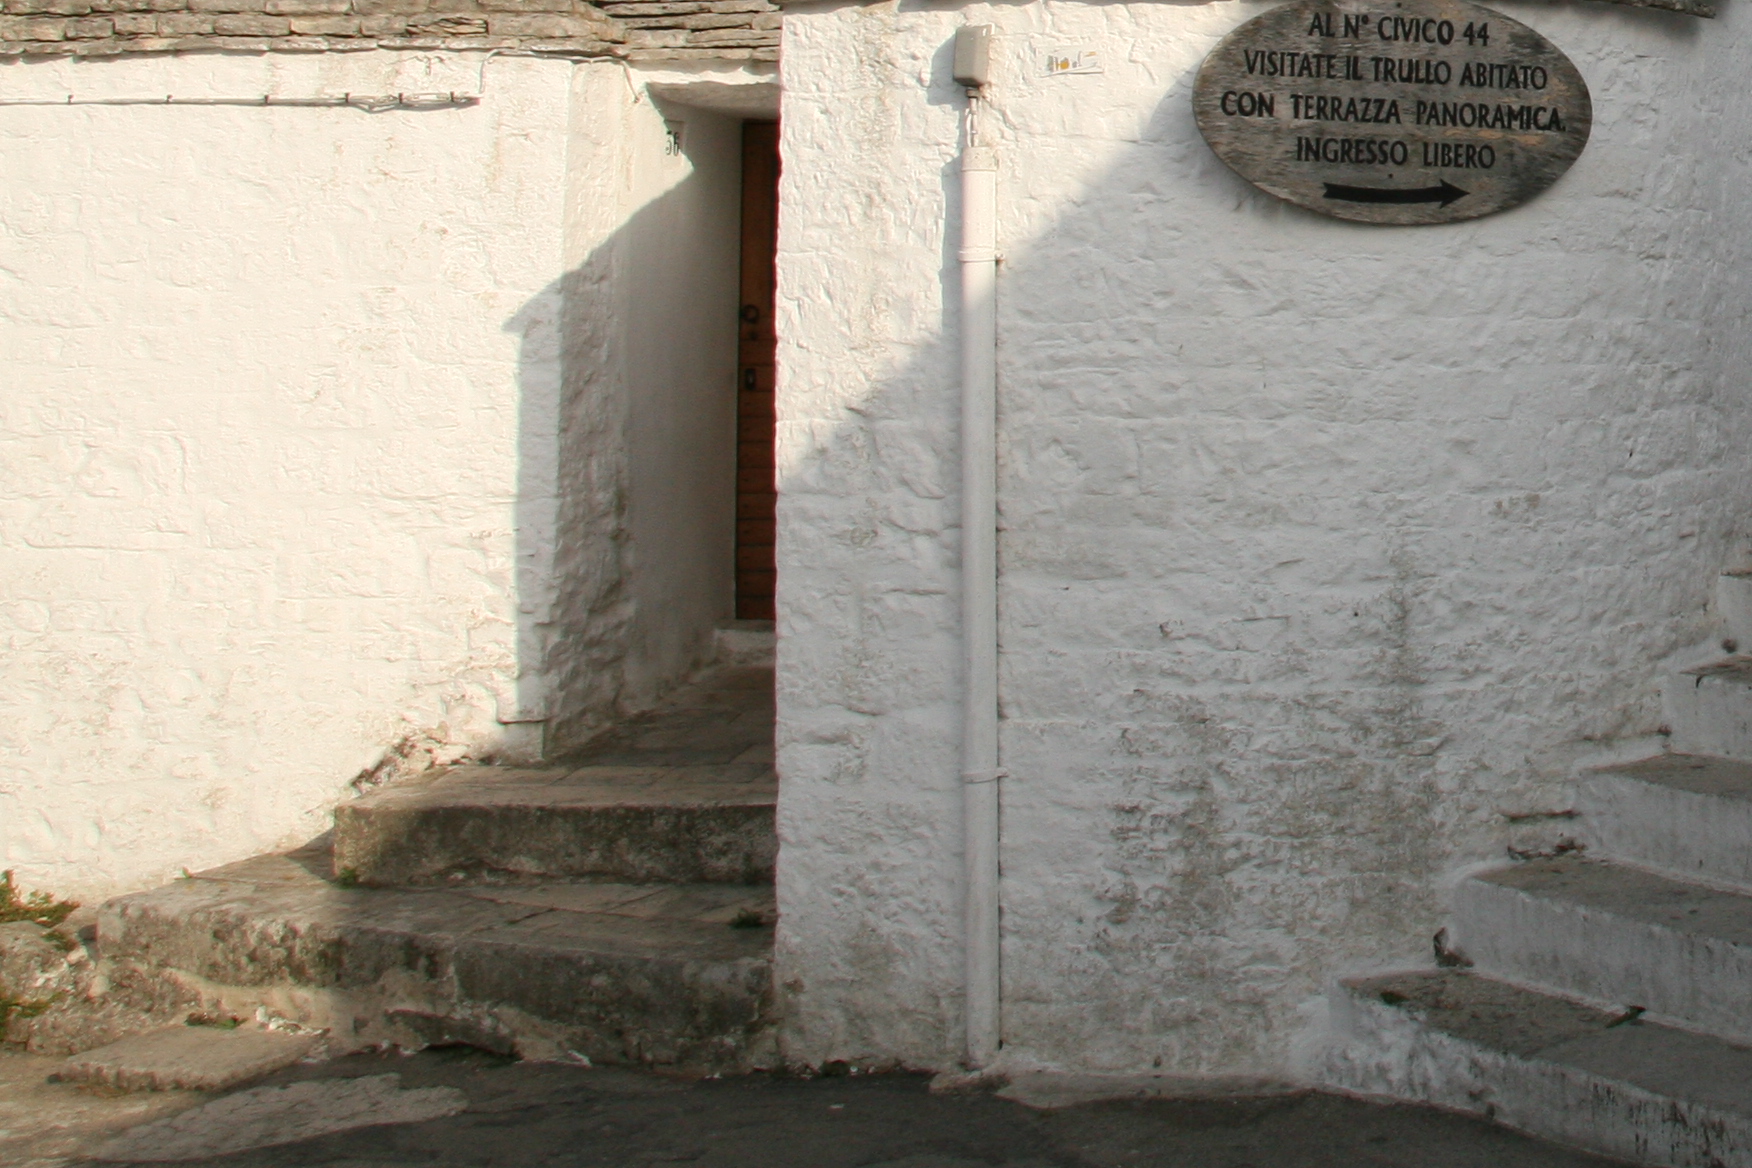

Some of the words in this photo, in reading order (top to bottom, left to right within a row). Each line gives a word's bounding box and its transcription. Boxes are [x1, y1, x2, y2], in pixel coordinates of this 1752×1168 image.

[1307, 12, 1335, 38] AL
[1377, 16, 1455, 45] CIVICO
[1463, 22, 1489, 46] 44
[1244, 49, 1337, 79] VISITATE
[1344, 56, 1363, 81] IL
[1371, 56, 1452, 85] TRULLO
[1459, 63, 1547, 90] ABITATO
[1220, 90, 1275, 118] CON
[1290, 93, 1400, 124] TERRAZZA
[1296, 136, 1408, 165] INGRESSO
[1423, 143, 1496, 169] LIBERO
